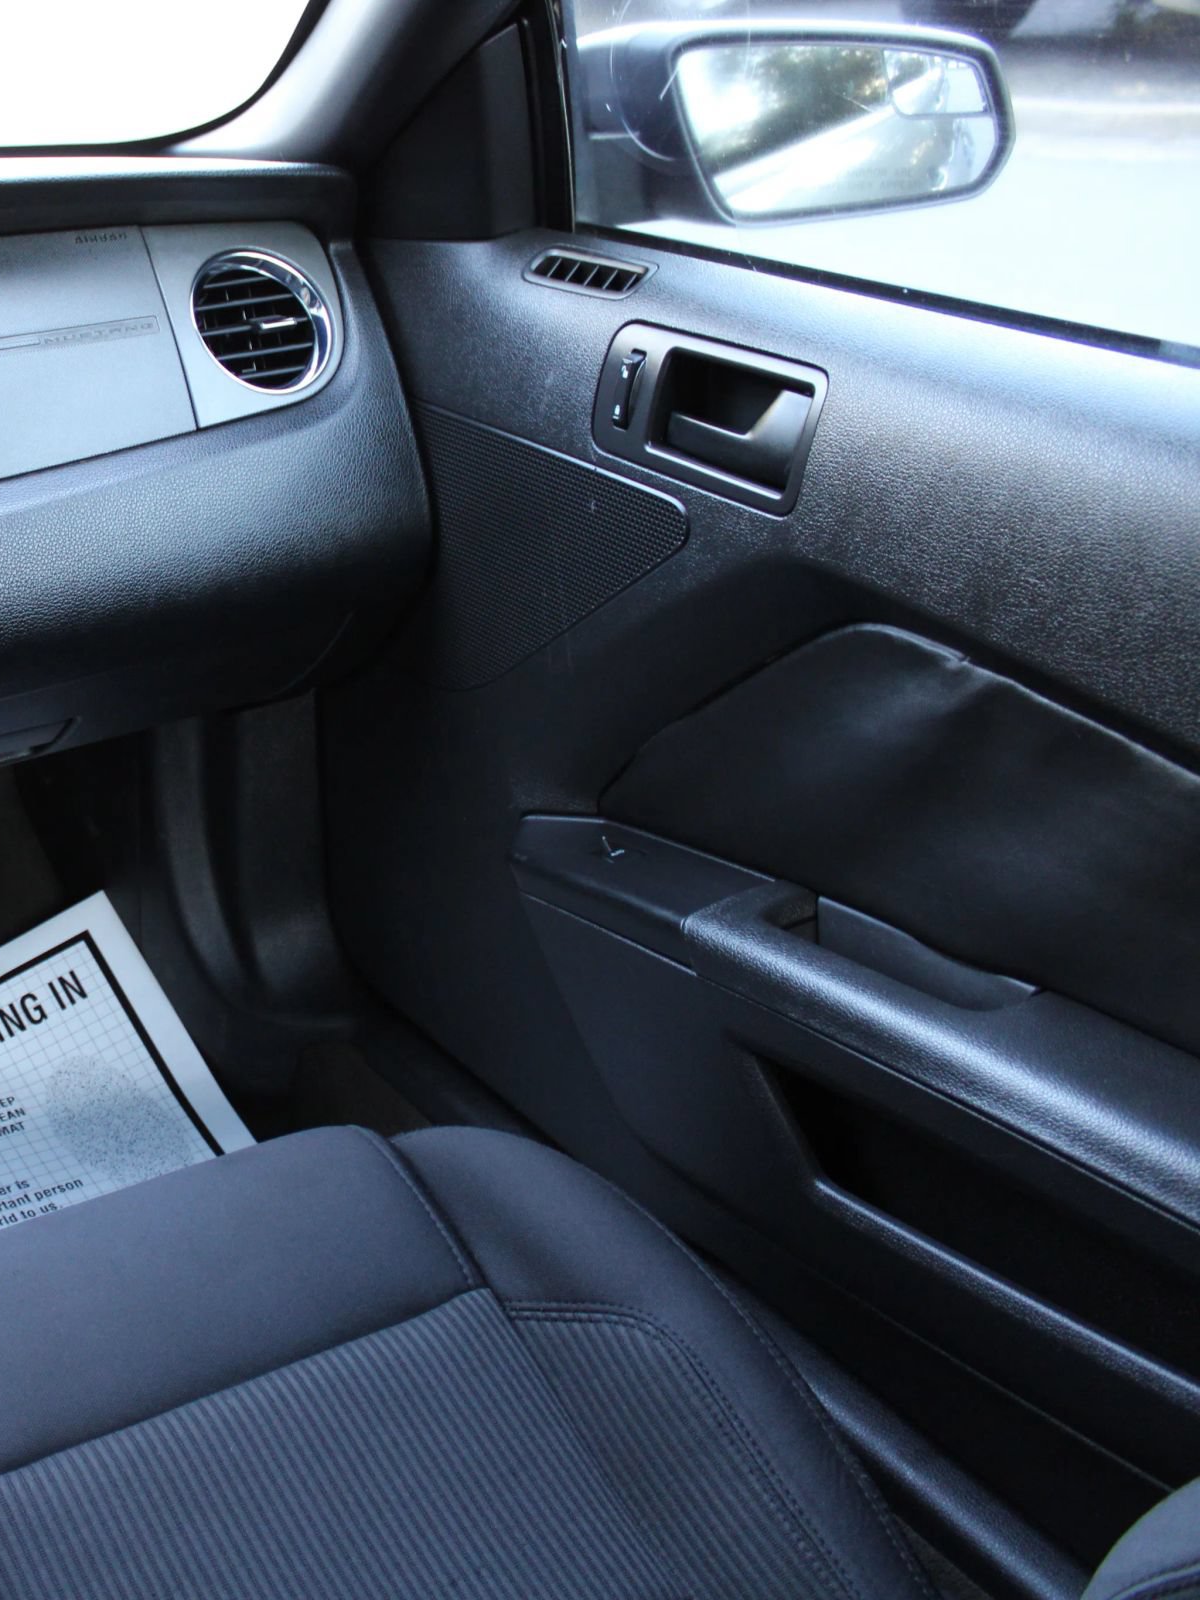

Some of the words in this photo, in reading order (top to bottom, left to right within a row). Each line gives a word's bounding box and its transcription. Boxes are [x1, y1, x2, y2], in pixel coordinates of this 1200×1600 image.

[49, 969, 88, 1012] IN
[15, 1178, 30, 1189] is
[34, 1178, 84, 1203] person
[20, 1208, 36, 1220] to
[40, 1201, 63, 1214] us.
